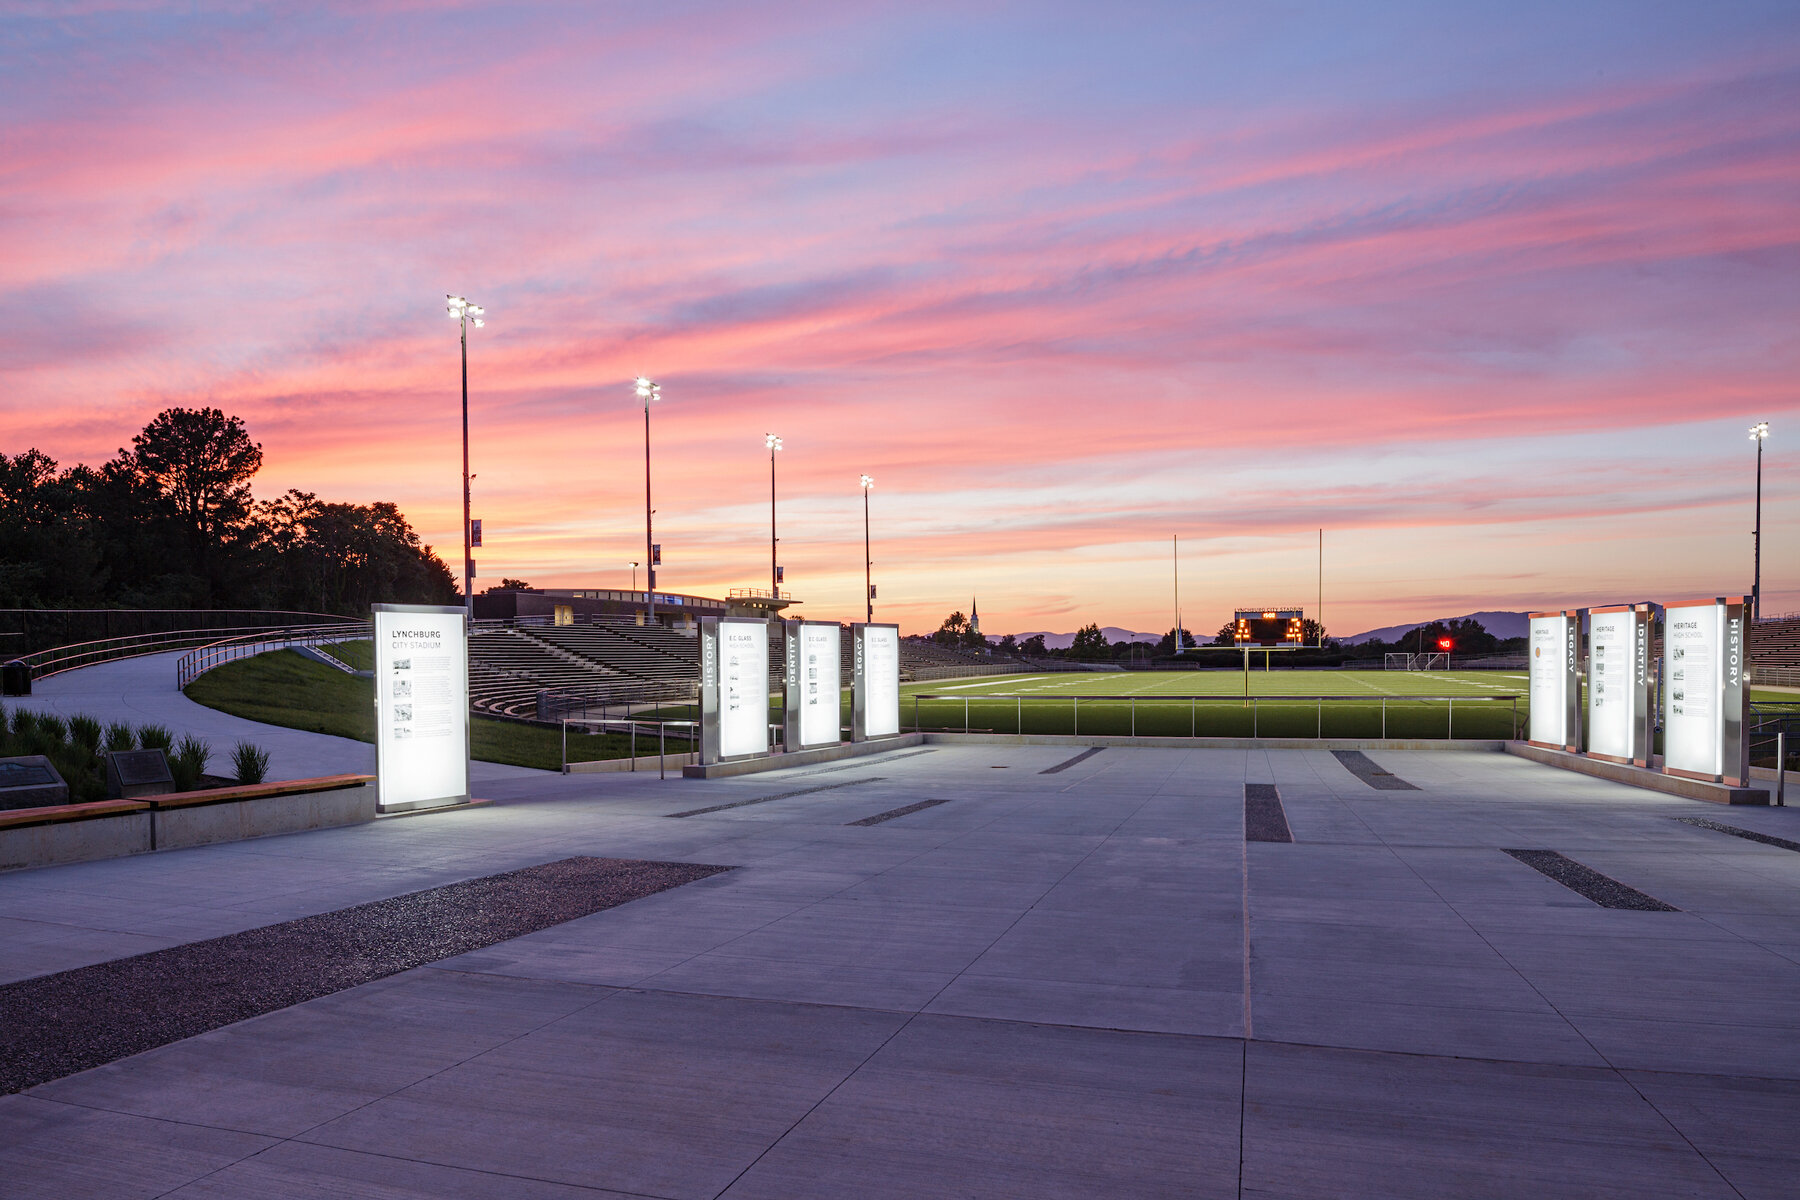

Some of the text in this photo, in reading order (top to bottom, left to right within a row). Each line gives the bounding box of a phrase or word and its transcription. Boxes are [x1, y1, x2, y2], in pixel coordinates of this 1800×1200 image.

[1674, 622, 1698, 630] HERITAGE
[392, 630, 441, 638] LYNCHBURG
[1730, 618, 1738, 686] HISTORY
